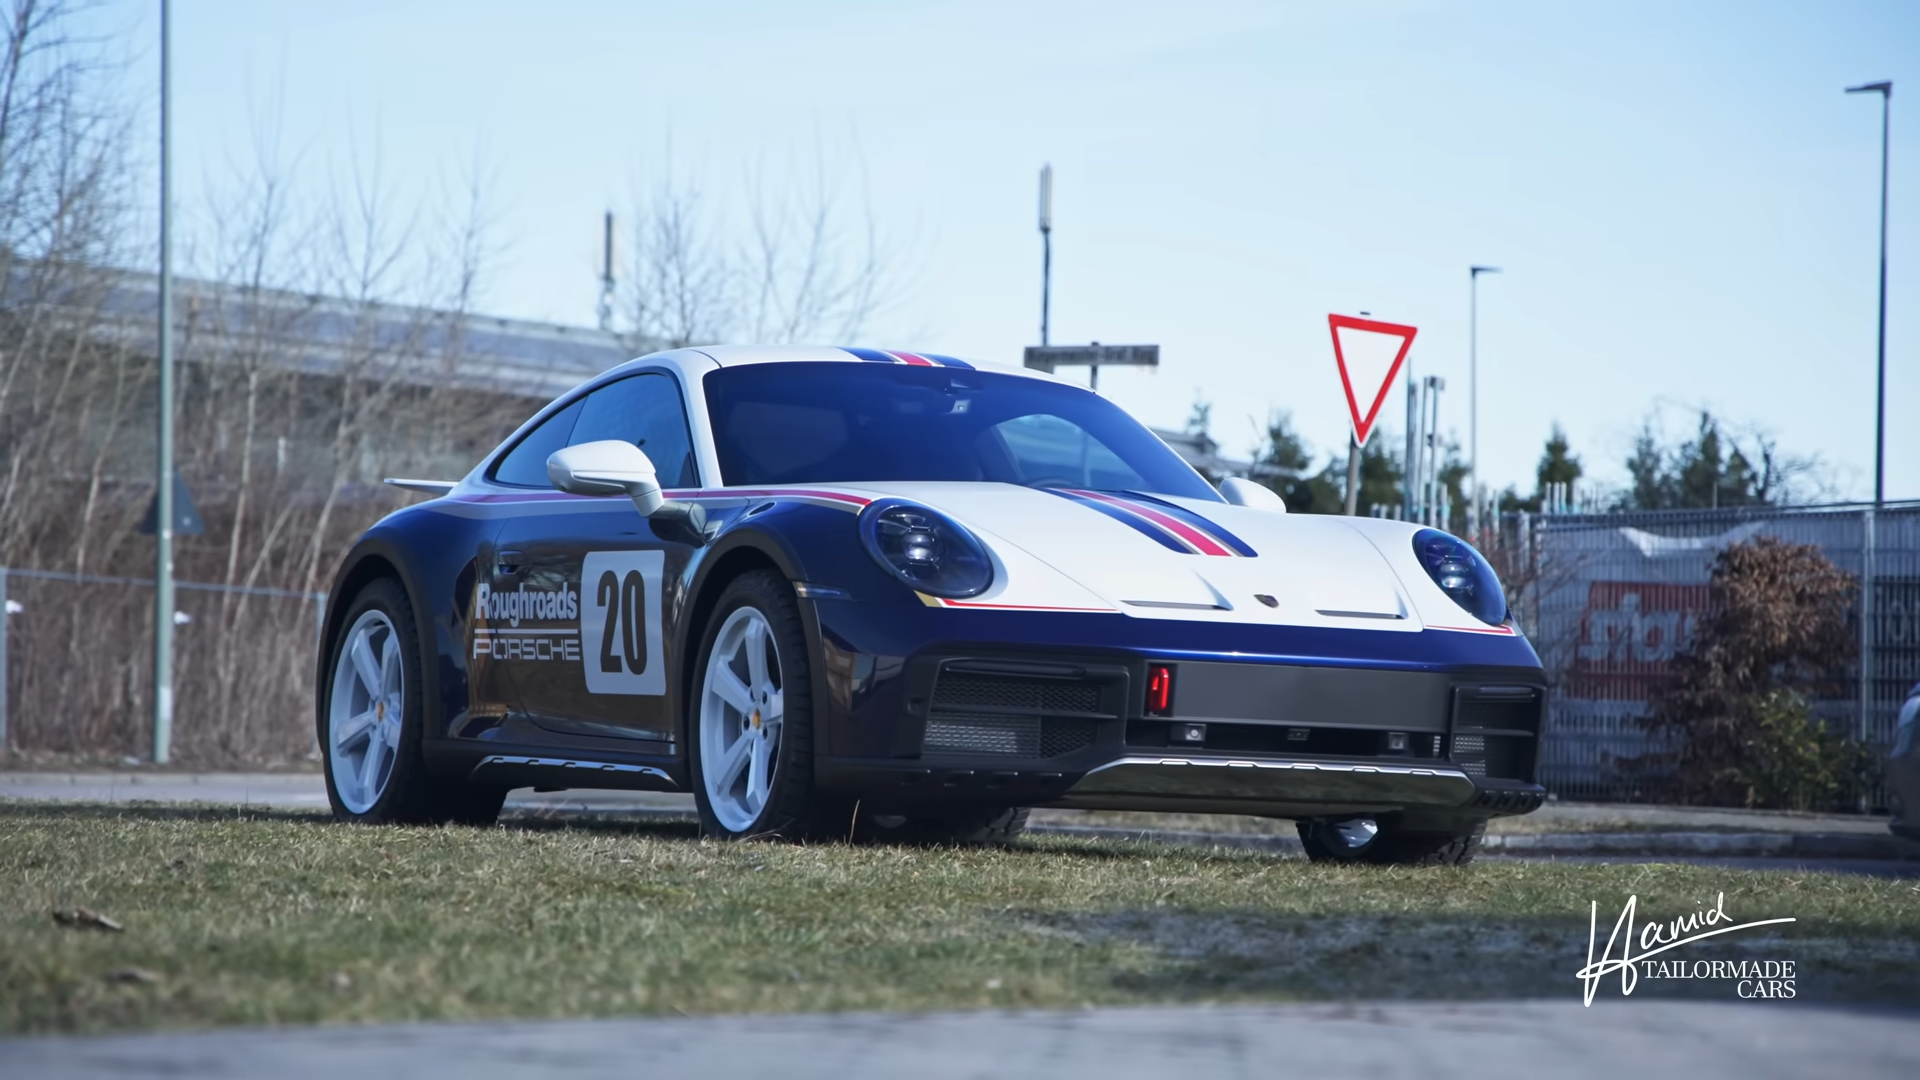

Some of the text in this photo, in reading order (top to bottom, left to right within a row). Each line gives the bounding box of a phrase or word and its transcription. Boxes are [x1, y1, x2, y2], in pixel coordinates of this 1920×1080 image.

[475, 582, 577, 627] Roughroads
[597, 570, 647, 675] 20
[473, 639, 580, 661] PORSCHE
